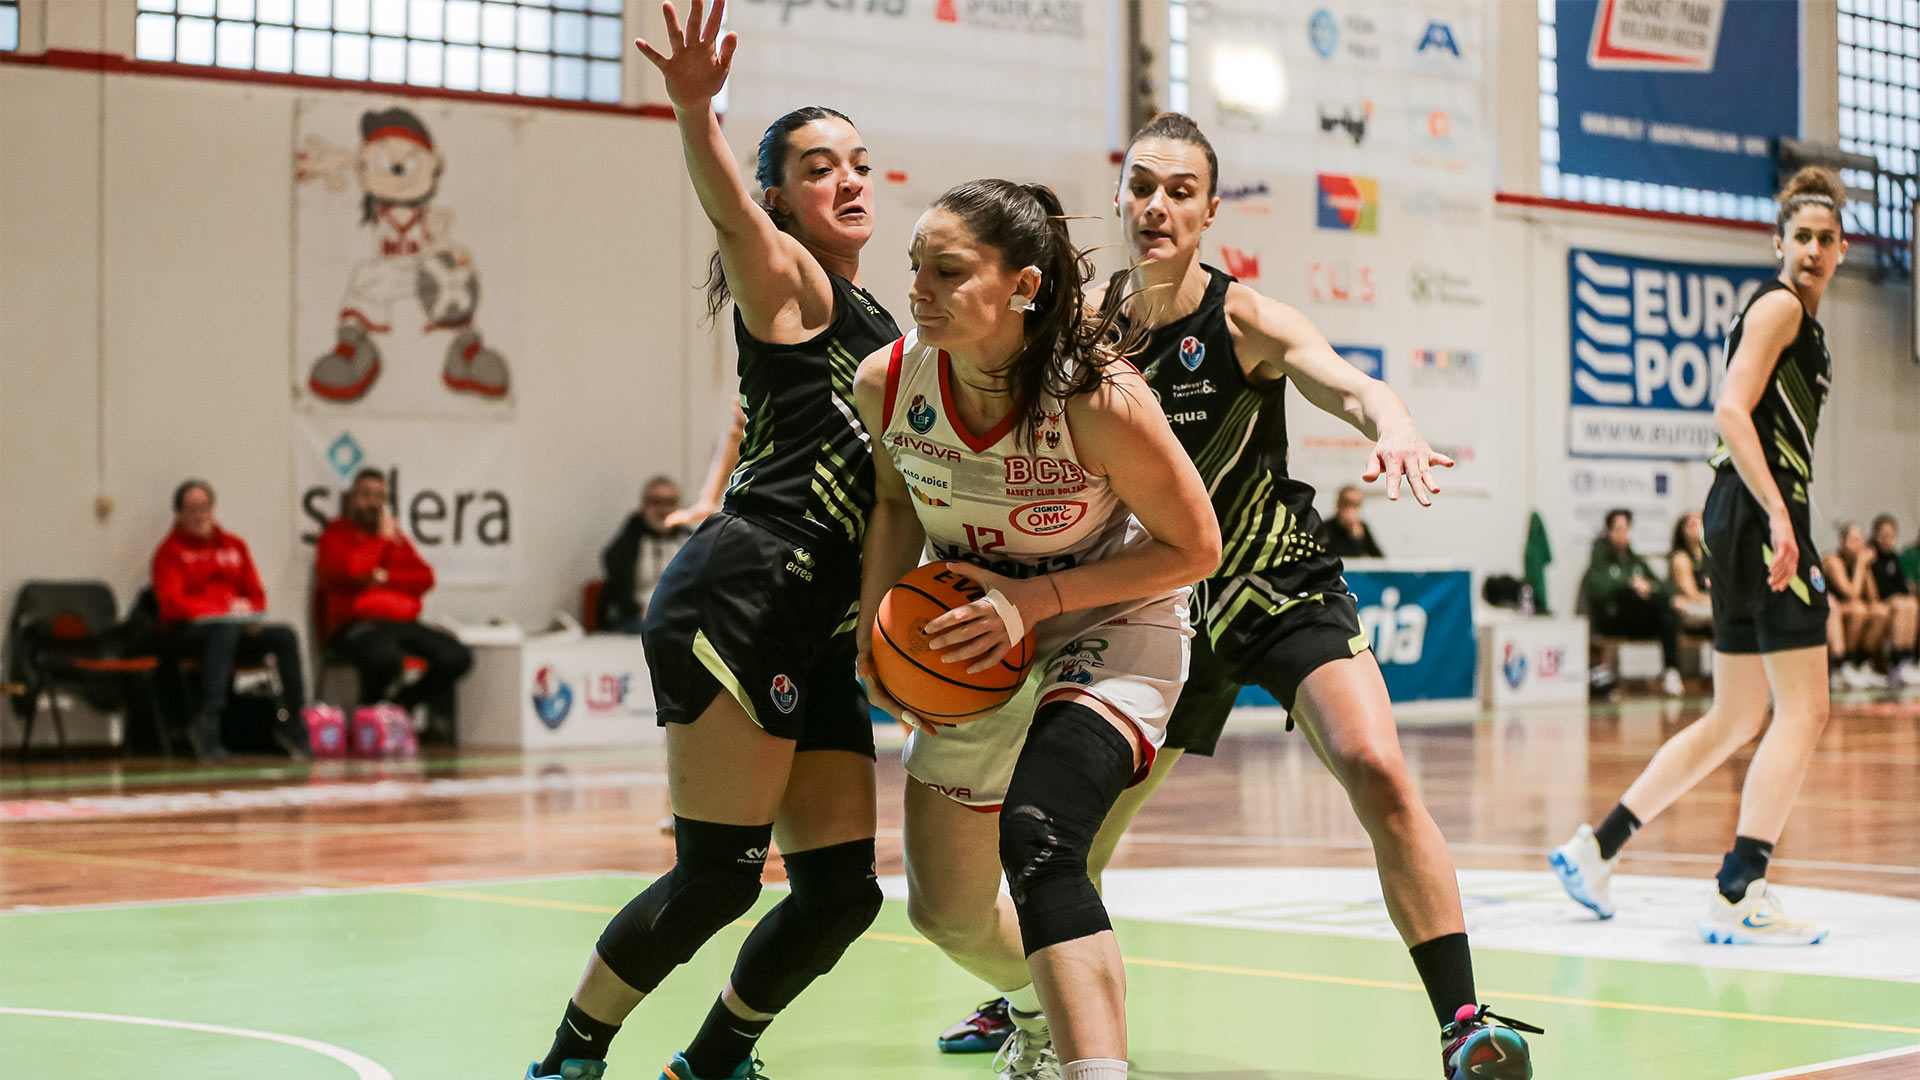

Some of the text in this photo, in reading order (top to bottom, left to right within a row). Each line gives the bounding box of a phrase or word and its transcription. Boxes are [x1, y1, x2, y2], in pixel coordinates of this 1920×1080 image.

[920, 475, 949, 489] ADIGE
[1005, 488, 1034, 497] BASKET
[1036, 488, 1056, 496] CLUB
[301, 466, 511, 546] slera
[1033, 505, 1067, 513] CIGNOLI
[1027, 508, 1073, 527] OMC
[962, 523, 1005, 554] 12
